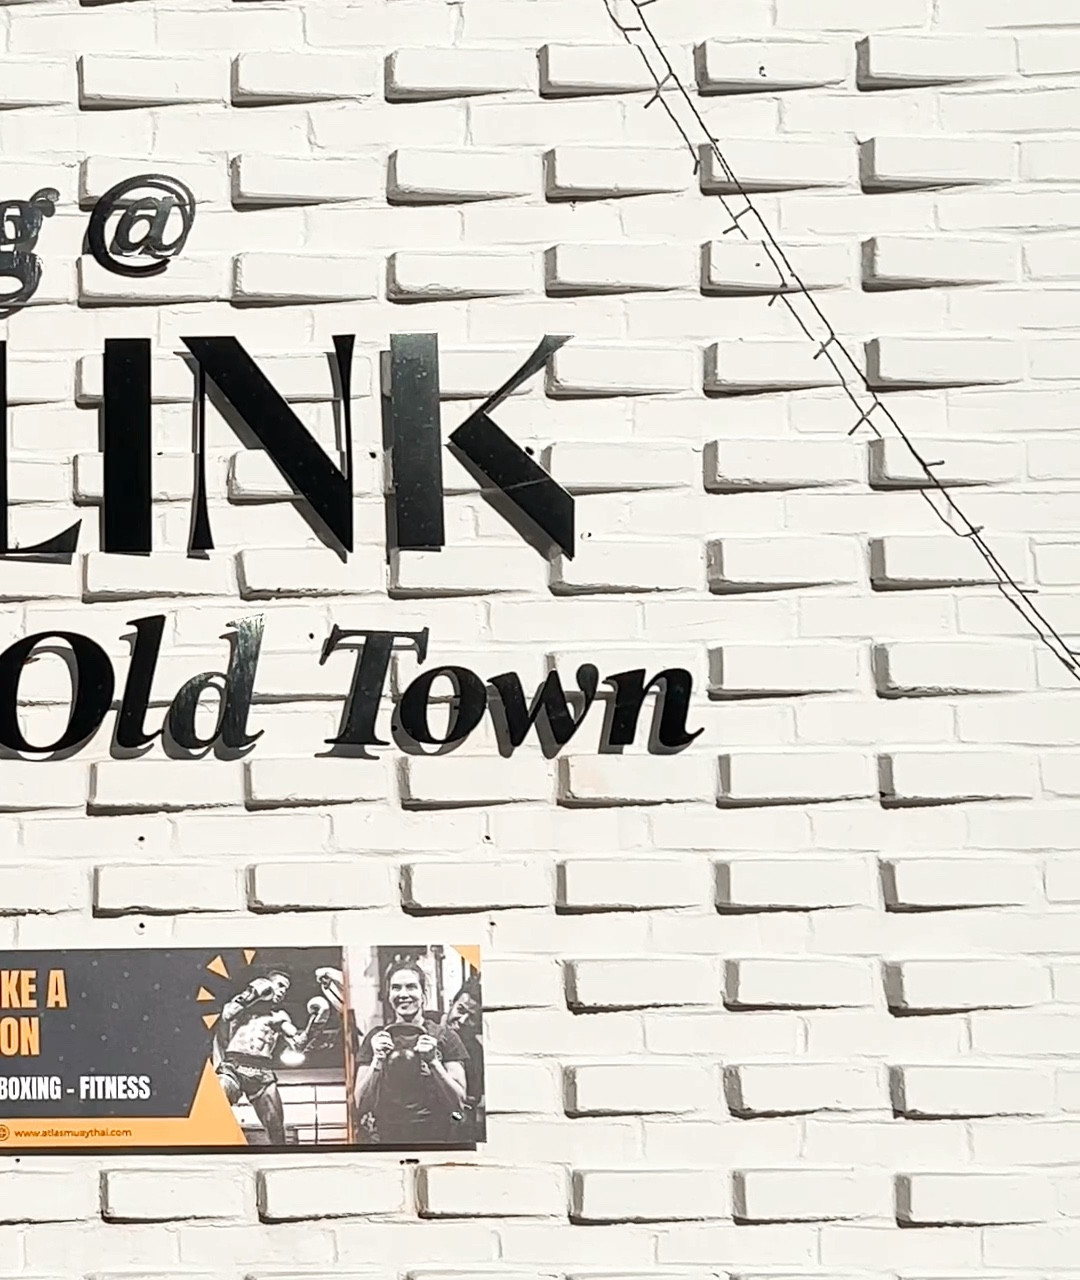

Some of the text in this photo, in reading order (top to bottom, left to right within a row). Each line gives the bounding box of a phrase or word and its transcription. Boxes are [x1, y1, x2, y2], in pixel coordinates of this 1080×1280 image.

[87, 173, 195, 276] @
[322, 625, 705, 756] Town
[46, 969, 69, 1008] A
[79, 1075, 151, 1101] FITNESS
[14, 1127, 133, 1139] www.atlasmuaythai.com
